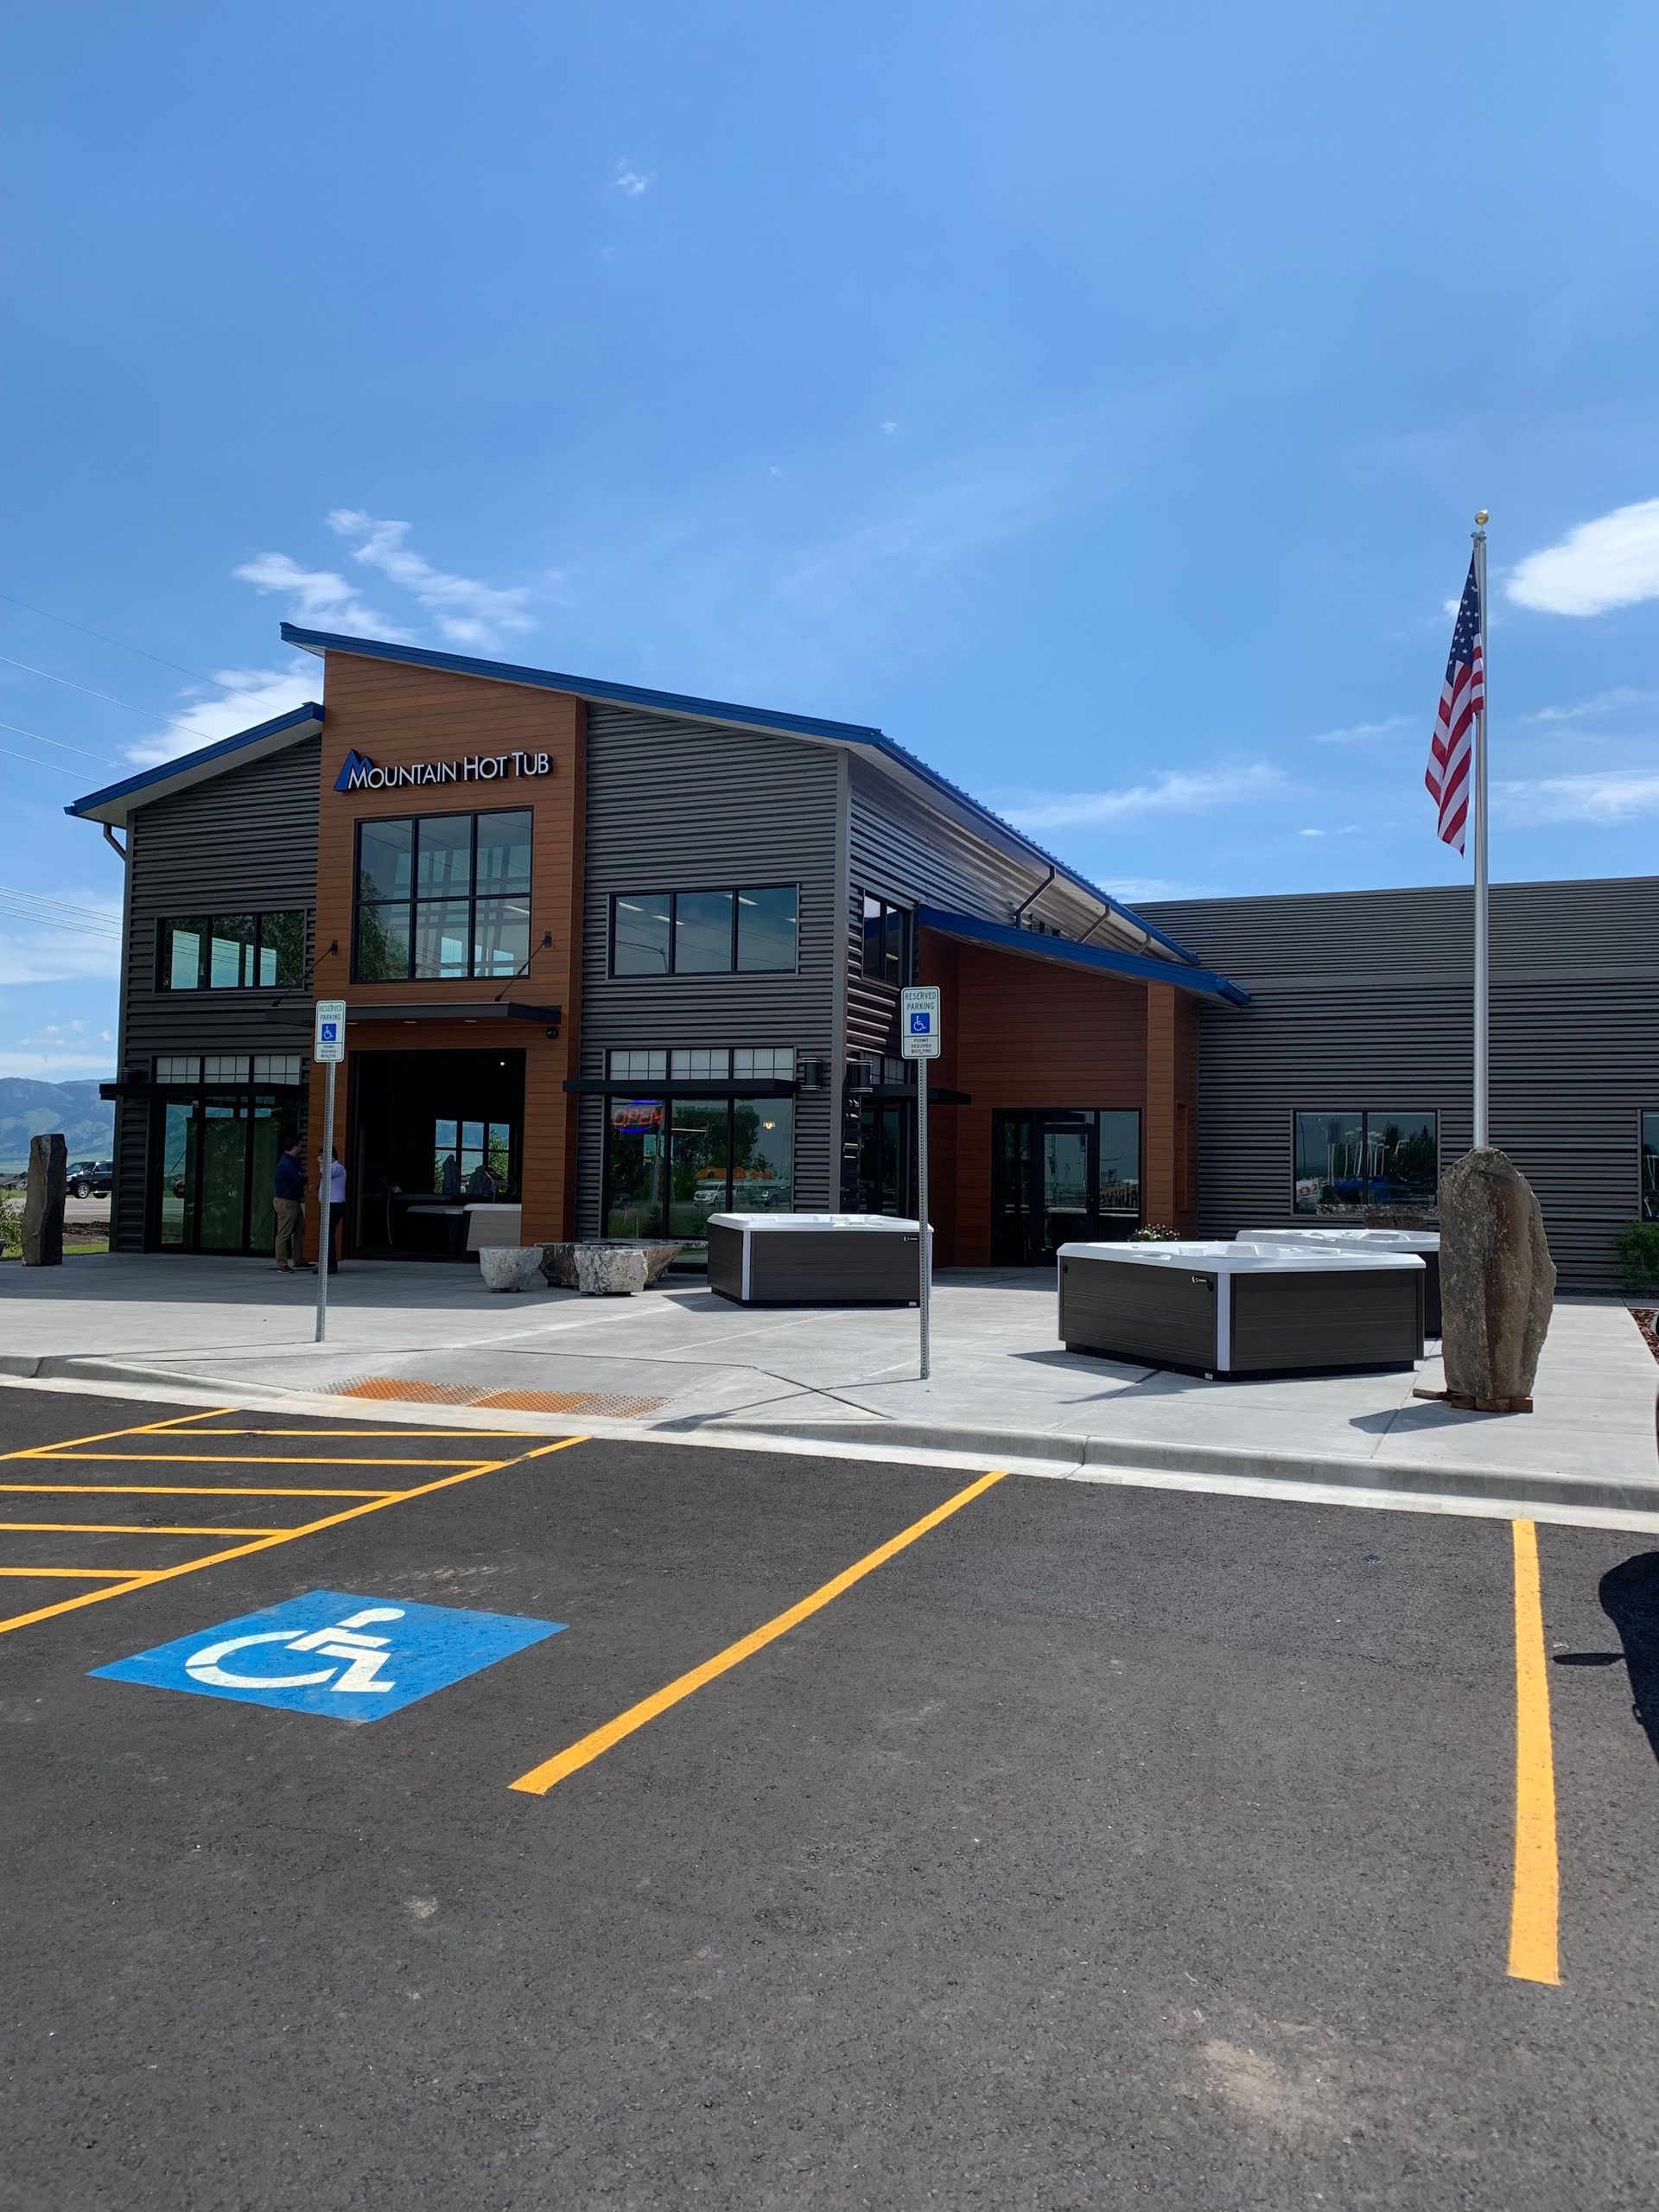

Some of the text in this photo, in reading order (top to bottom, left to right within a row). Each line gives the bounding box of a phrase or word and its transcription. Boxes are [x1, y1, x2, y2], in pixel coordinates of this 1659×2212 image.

[347, 751, 550, 789] MOUNTAIN HOT TUB
[905, 992, 937, 1001] RESERVED
[319, 1004, 343, 1013] RESERVED
[613, 1107, 664, 1126] OPEN
